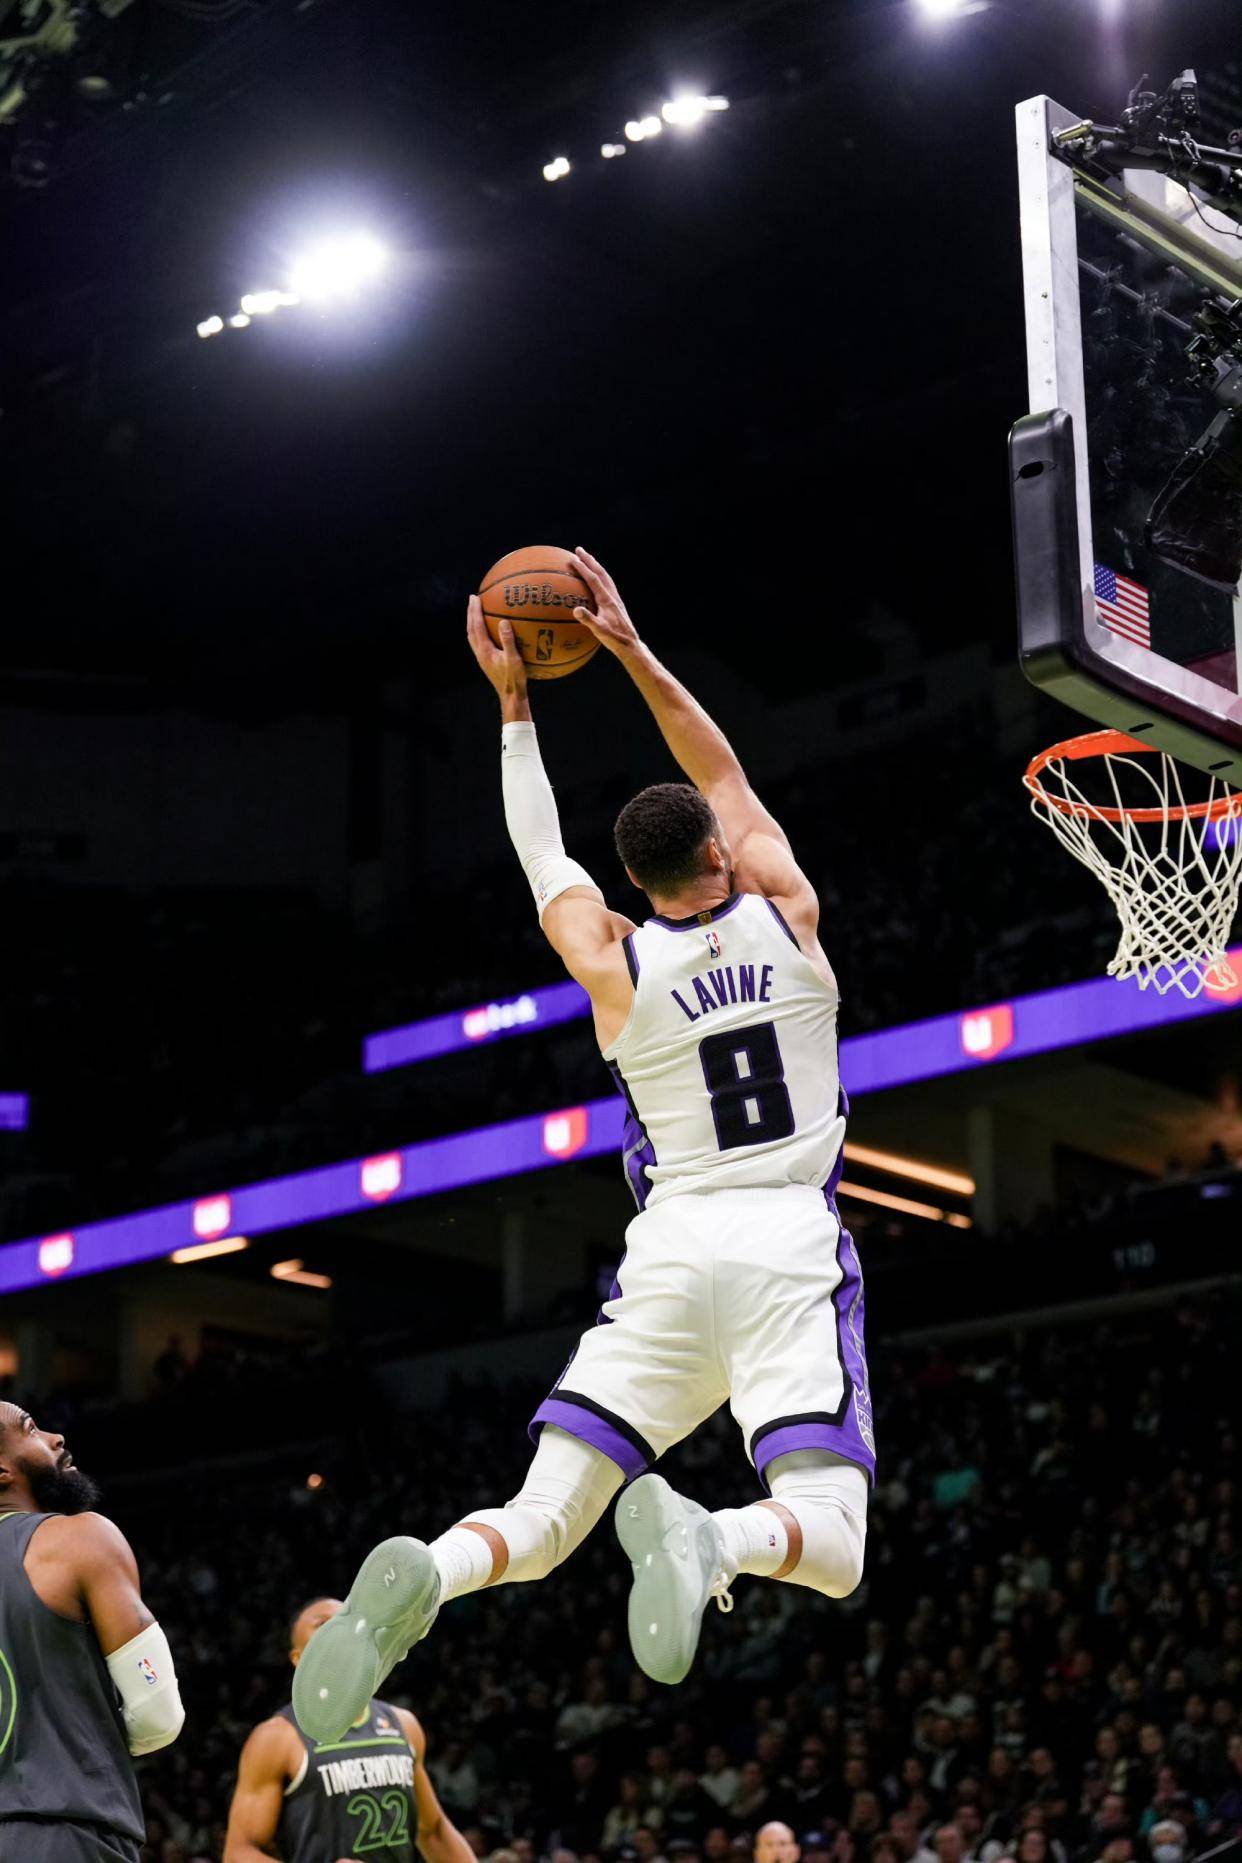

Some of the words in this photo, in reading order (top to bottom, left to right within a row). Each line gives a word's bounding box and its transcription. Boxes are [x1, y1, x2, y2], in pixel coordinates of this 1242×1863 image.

[671, 964, 774, 1022] LAVINE
[698, 1021, 796, 1151] 8
[347, 1790, 410, 1853] 22
